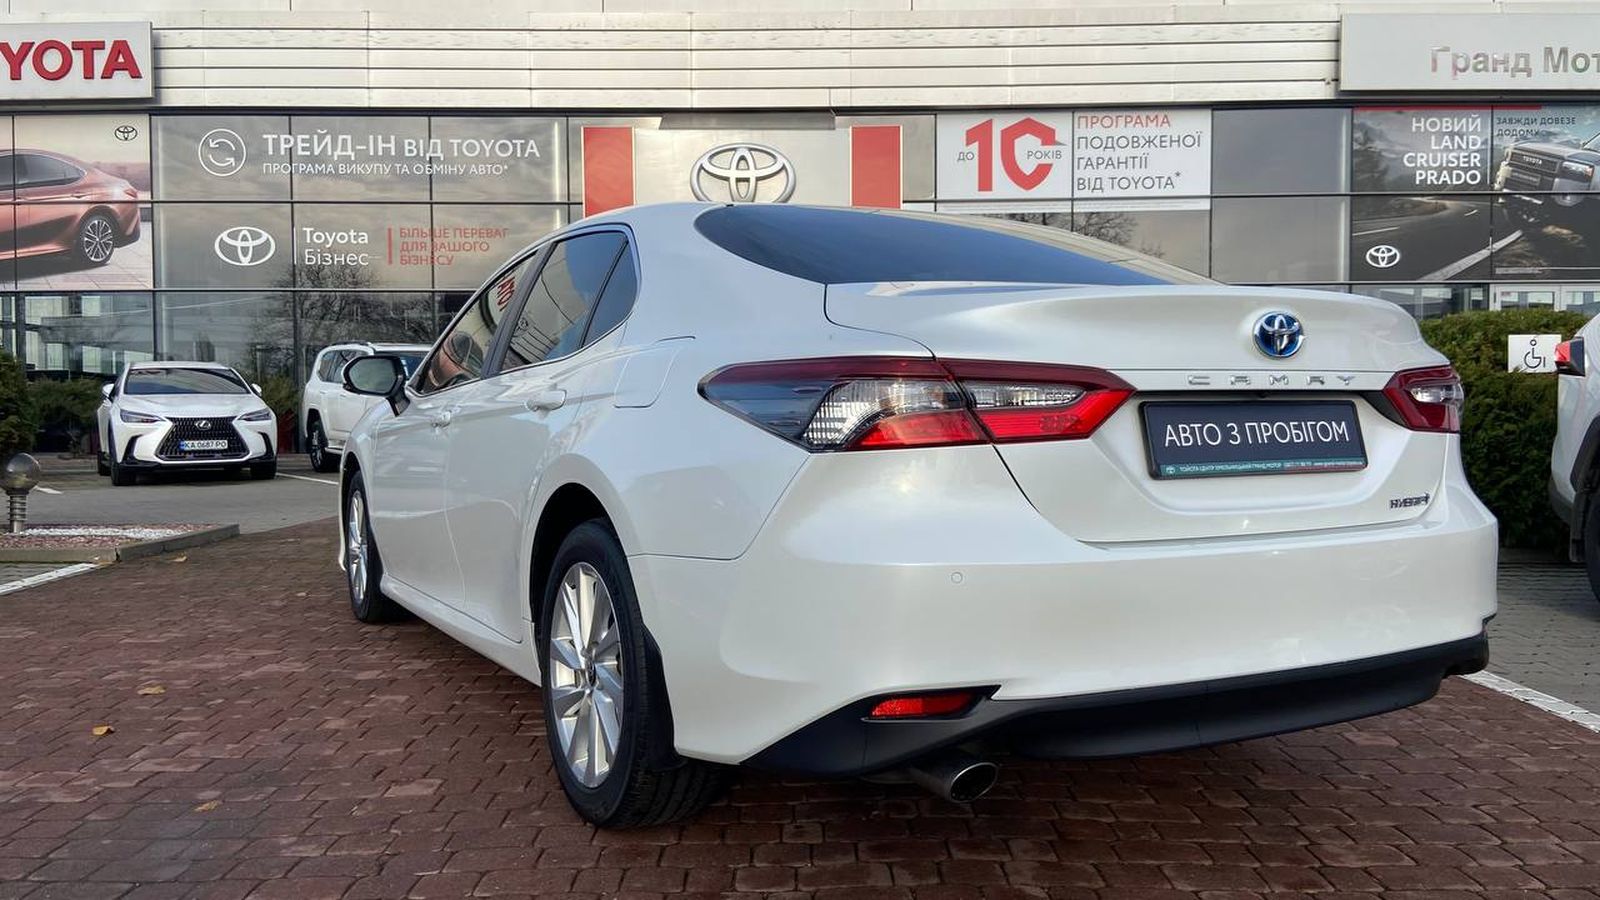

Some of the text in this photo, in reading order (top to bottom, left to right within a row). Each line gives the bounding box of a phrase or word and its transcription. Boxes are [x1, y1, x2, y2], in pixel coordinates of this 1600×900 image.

[1430, 46, 1532, 79] Гранд
[1076, 113, 1171, 130] ПРОГРАМА
[1411, 115, 1481, 133] НОВИЙ
[1496, 116, 1576, 126] ЗАВЖДИ ДОВЕЗЕ
[262, 129, 396, 160] ТРЕЙД-ІН
[404, 139, 444, 161] ВІД
[1076, 131, 1203, 151] ПОДОВЖЕНОЇ
[1431, 135, 1481, 150] LAND
[957, 151, 975, 163] ДО
[1026, 149, 1062, 161] РОКІВ
[1076, 152, 1149, 171] ГАРАНТІЇ
[1403, 152, 1481, 168] CRUISER
[263, 162, 335, 175] ПРОГРАМА
[338, 163, 392, 175] ВИКУПУ
[394, 163, 410, 175] ТА
[413, 163, 466, 175] ОБМІНУ
[1415, 169, 1481, 185] PRADO
[1077, 178, 1104, 193] ВІД
[302, 227, 369, 248] Toyota
[305, 248, 369, 266] Бізнес
[1165, 423, 1221, 447] АВТО
[1245, 420, 1350, 444] ПРОБІГОМ
